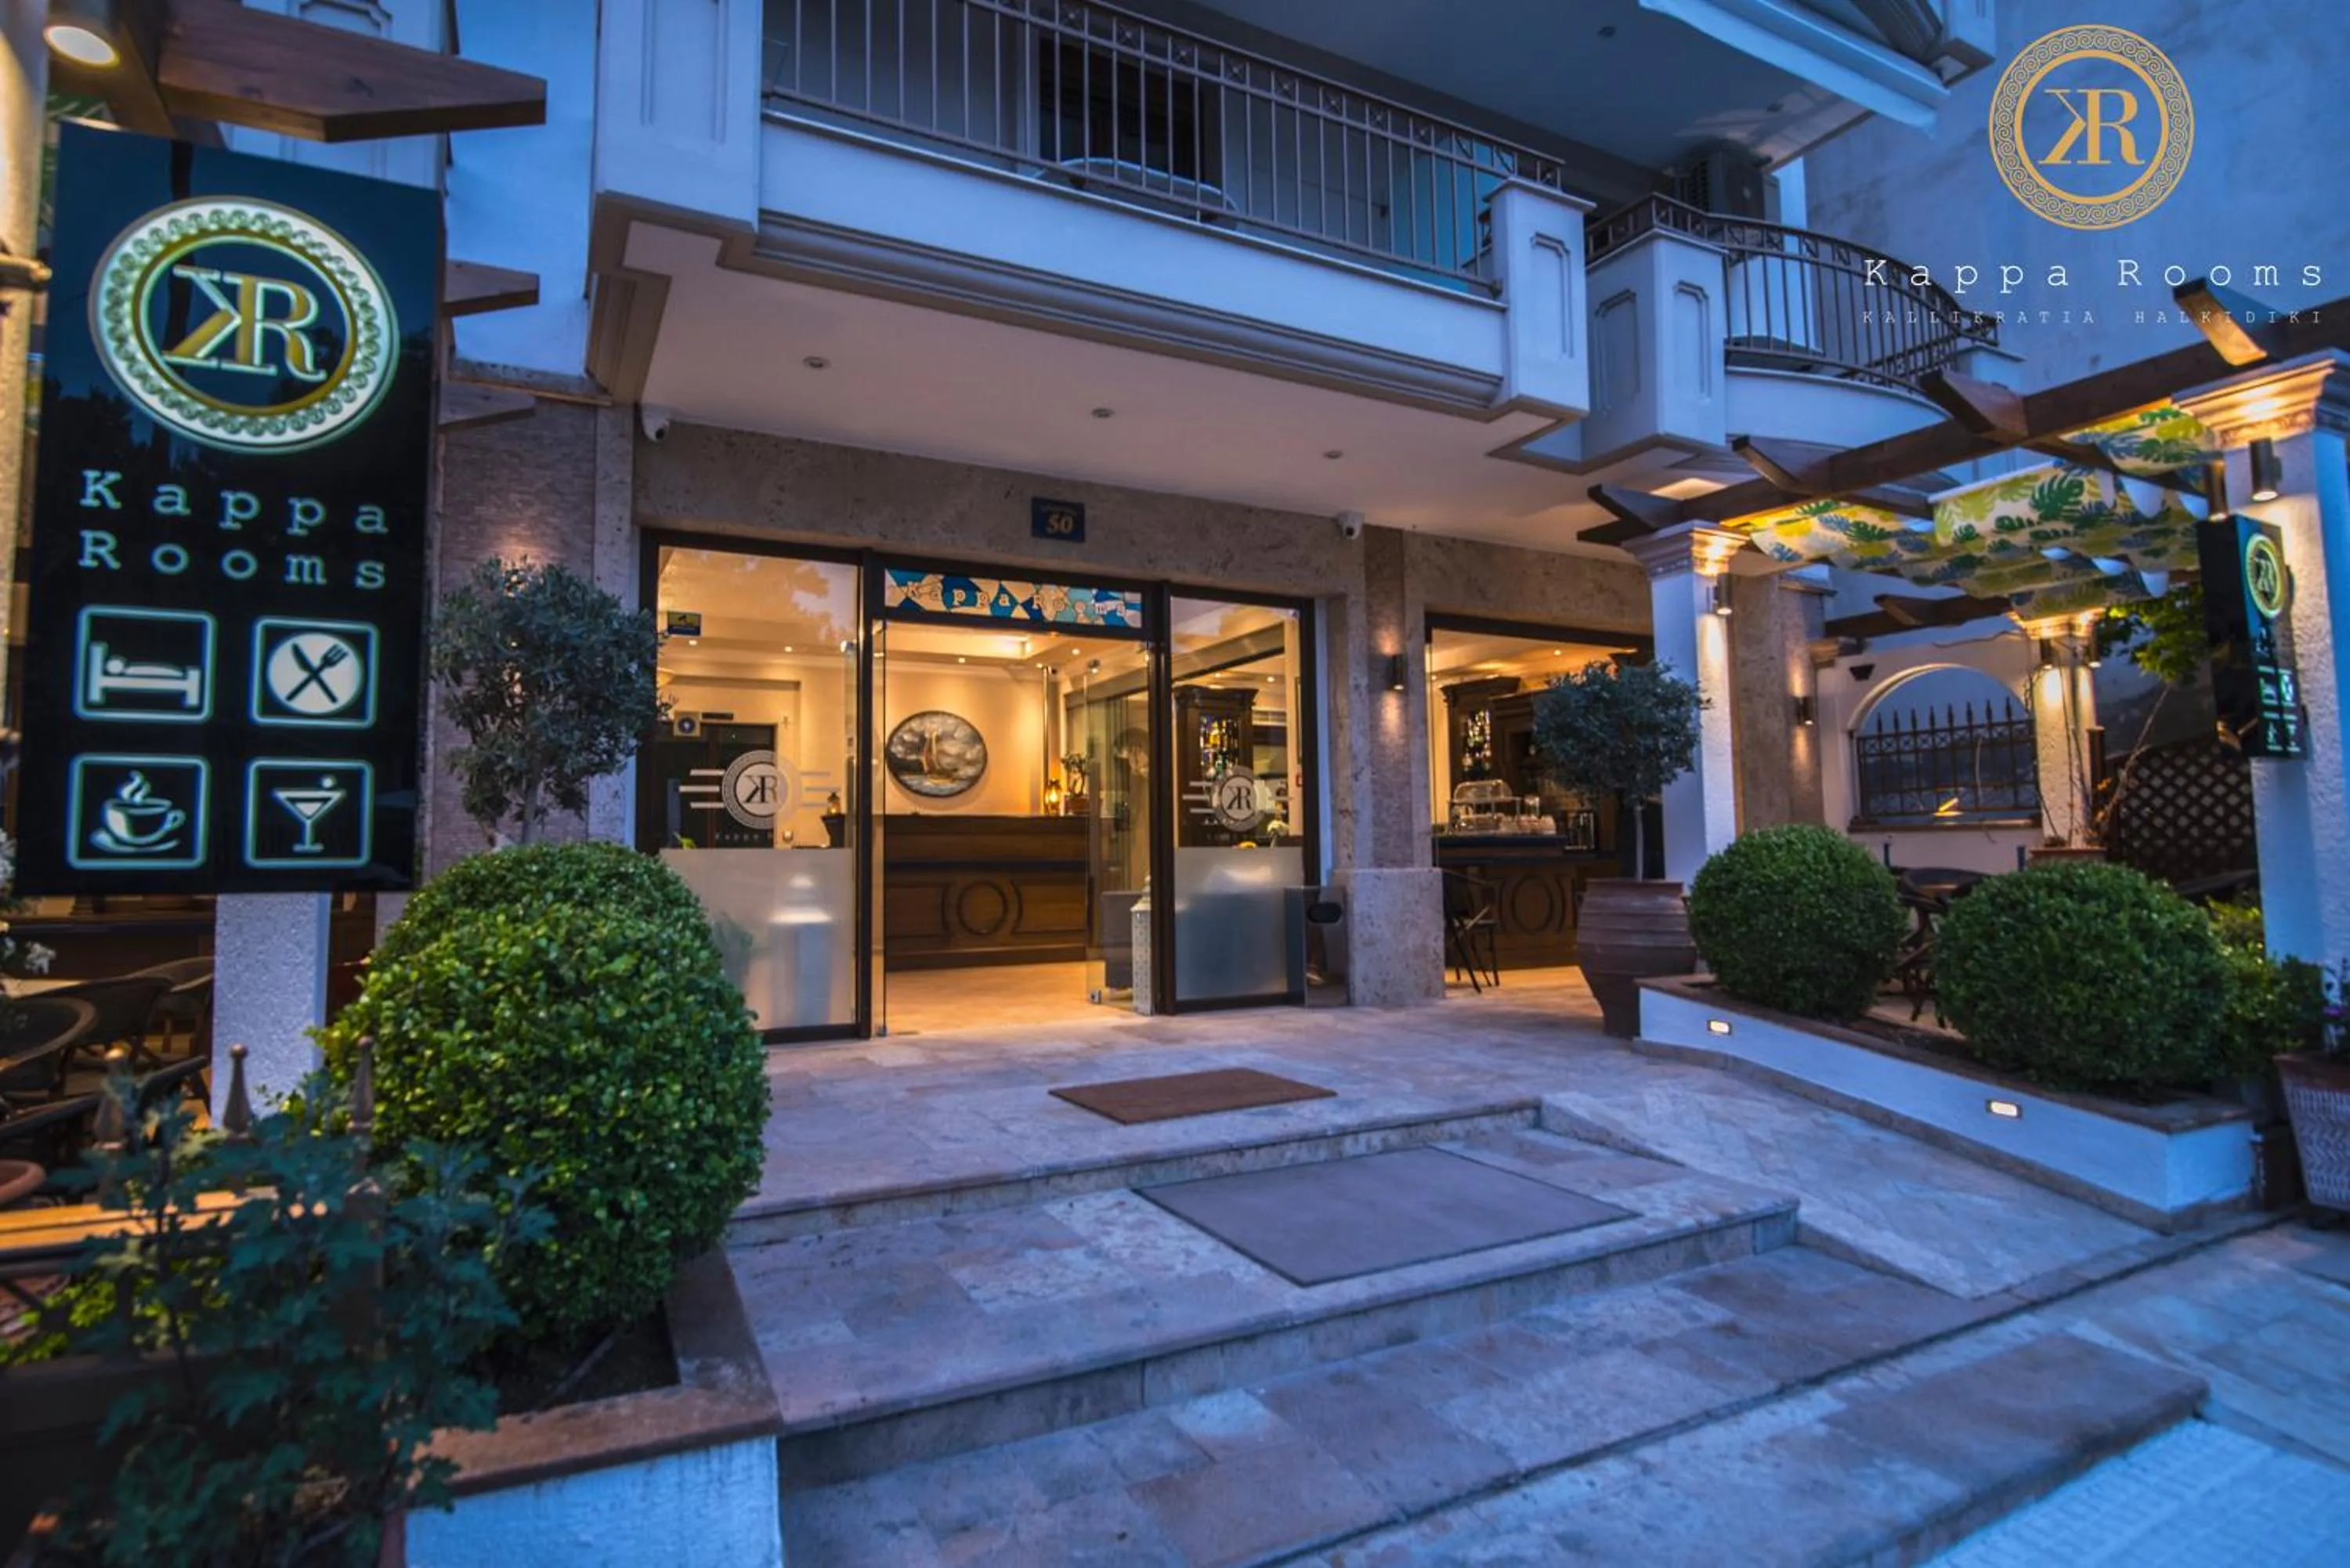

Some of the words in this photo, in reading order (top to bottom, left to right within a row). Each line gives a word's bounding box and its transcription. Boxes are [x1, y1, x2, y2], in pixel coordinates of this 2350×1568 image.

[80, 469, 389, 534] Kappa
[1047, 513, 1074, 534] 50
[78, 529, 386, 589] Rooms
